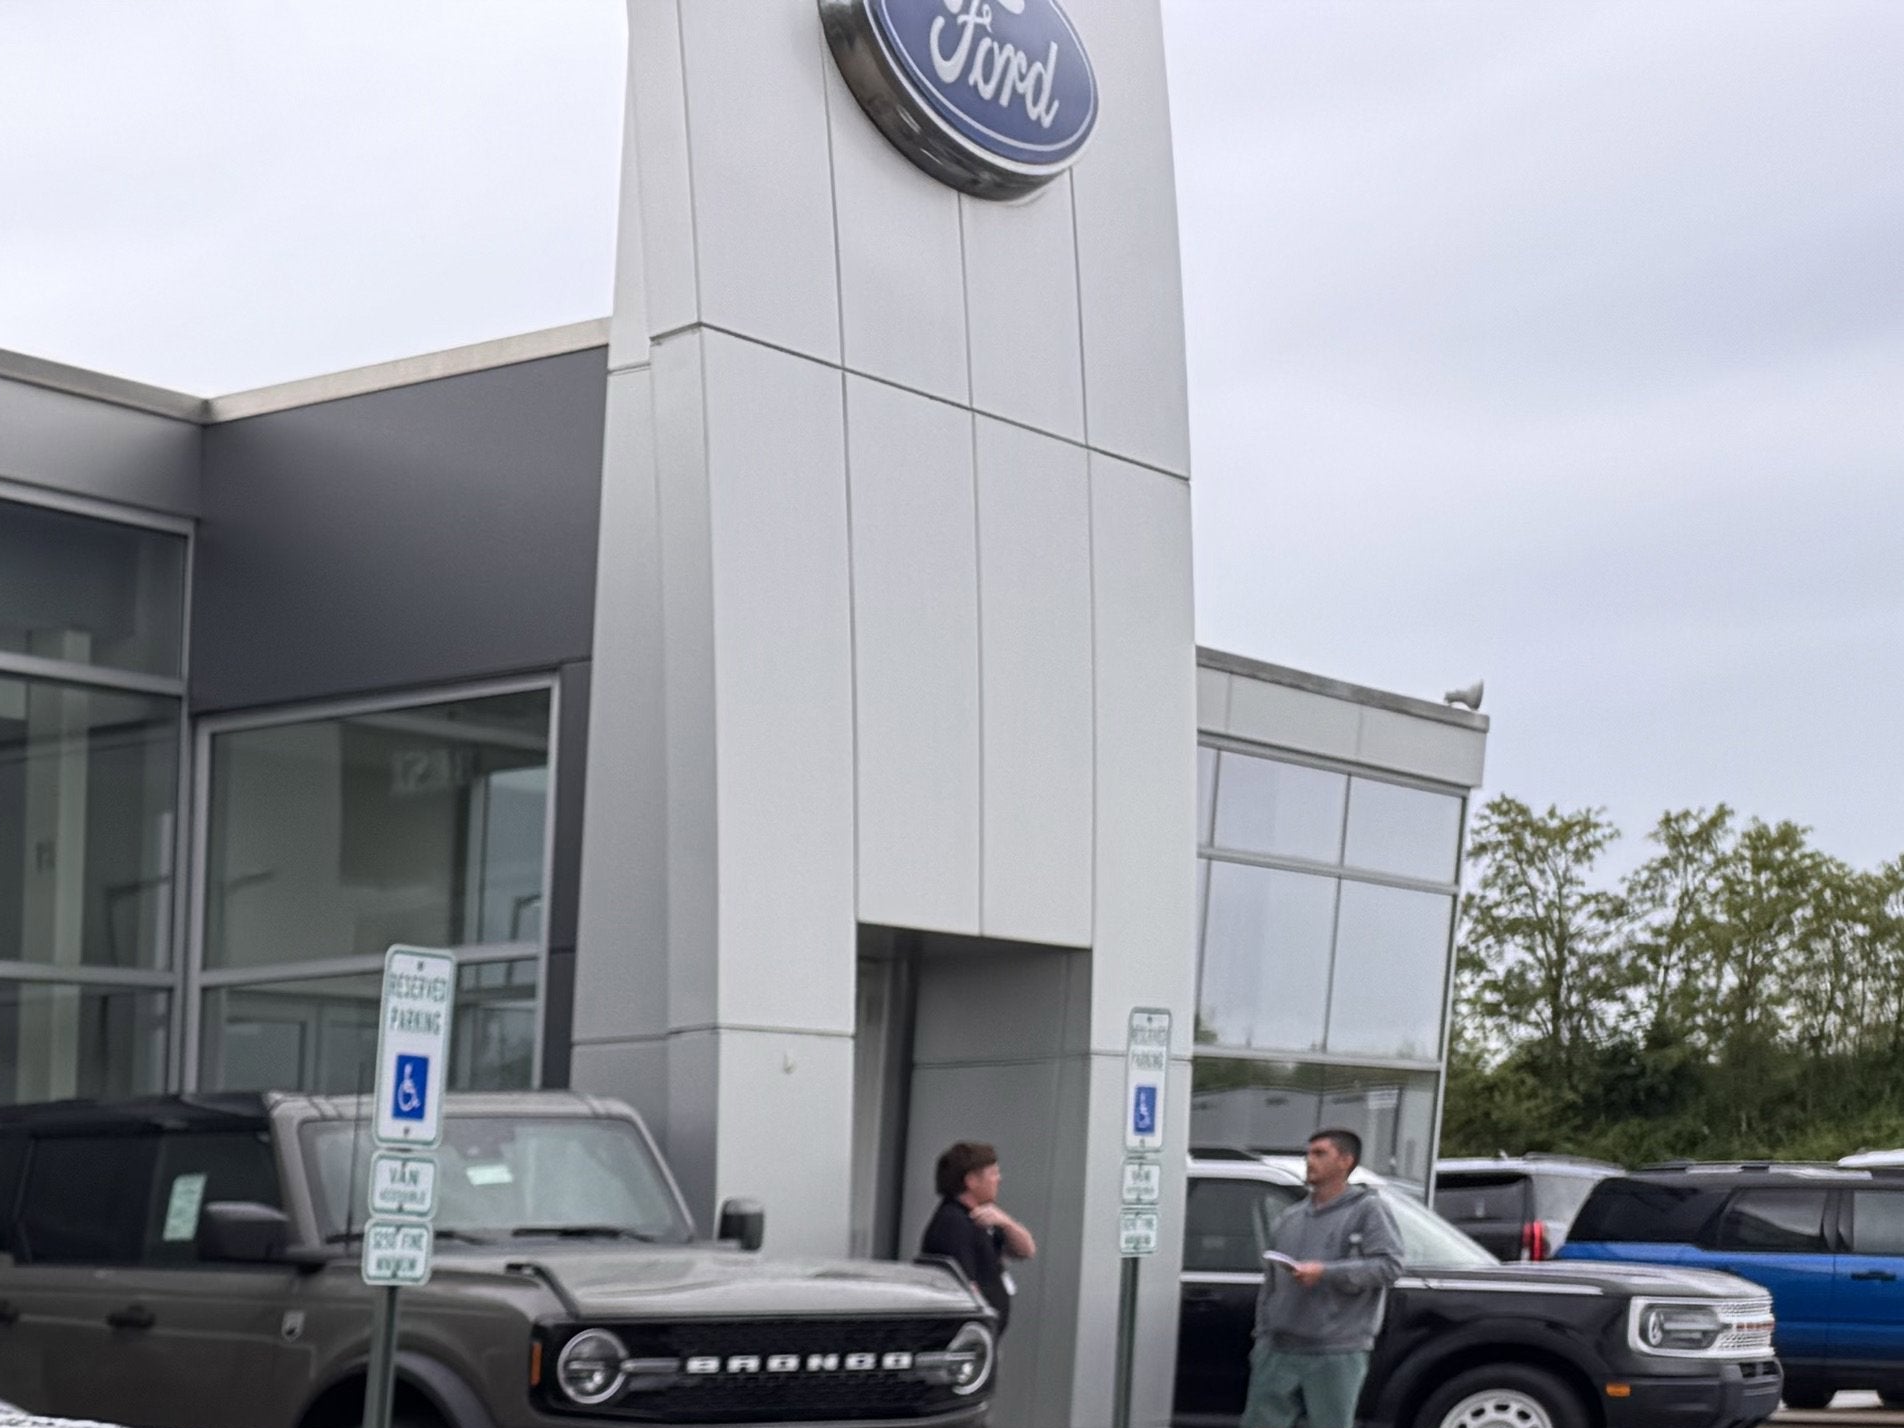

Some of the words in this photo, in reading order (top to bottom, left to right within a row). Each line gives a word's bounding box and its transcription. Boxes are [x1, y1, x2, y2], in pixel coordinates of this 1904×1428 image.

[930, 0, 1059, 129] Ford
[390, 1005, 441, 1035] PARKING
[389, 1166, 419, 1187] VAN
[685, 1351, 913, 1375] BRONCO
